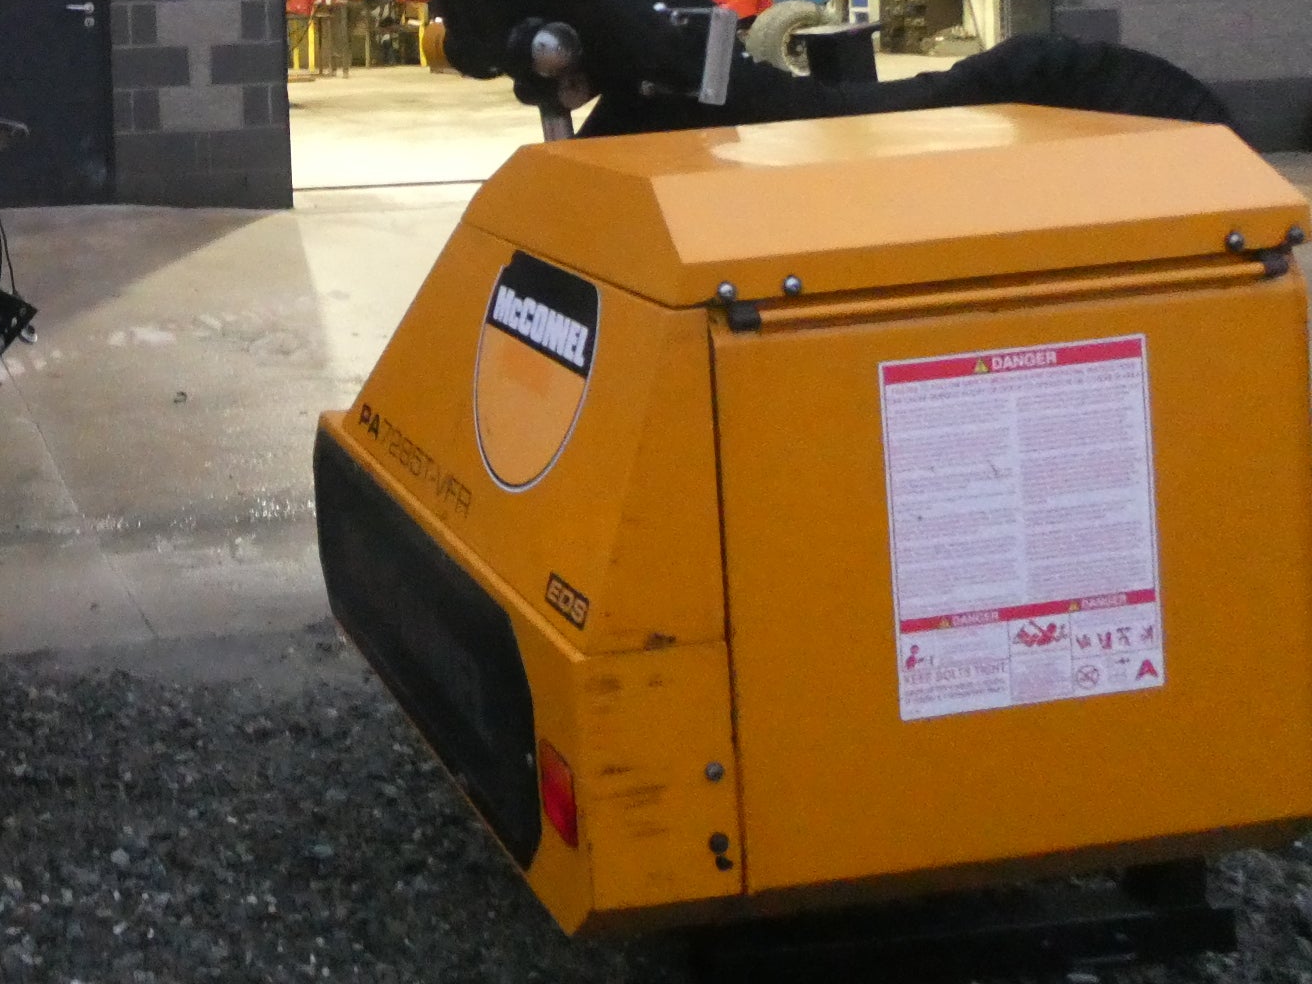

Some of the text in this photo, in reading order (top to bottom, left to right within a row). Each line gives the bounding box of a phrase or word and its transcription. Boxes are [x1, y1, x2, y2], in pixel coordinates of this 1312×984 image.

[492, 285, 590, 369] McCONNEL
[991, 351, 1057, 371] DANGER
[1081, 594, 1127, 610] DANGER
[952, 611, 1000, 627] DANGER
